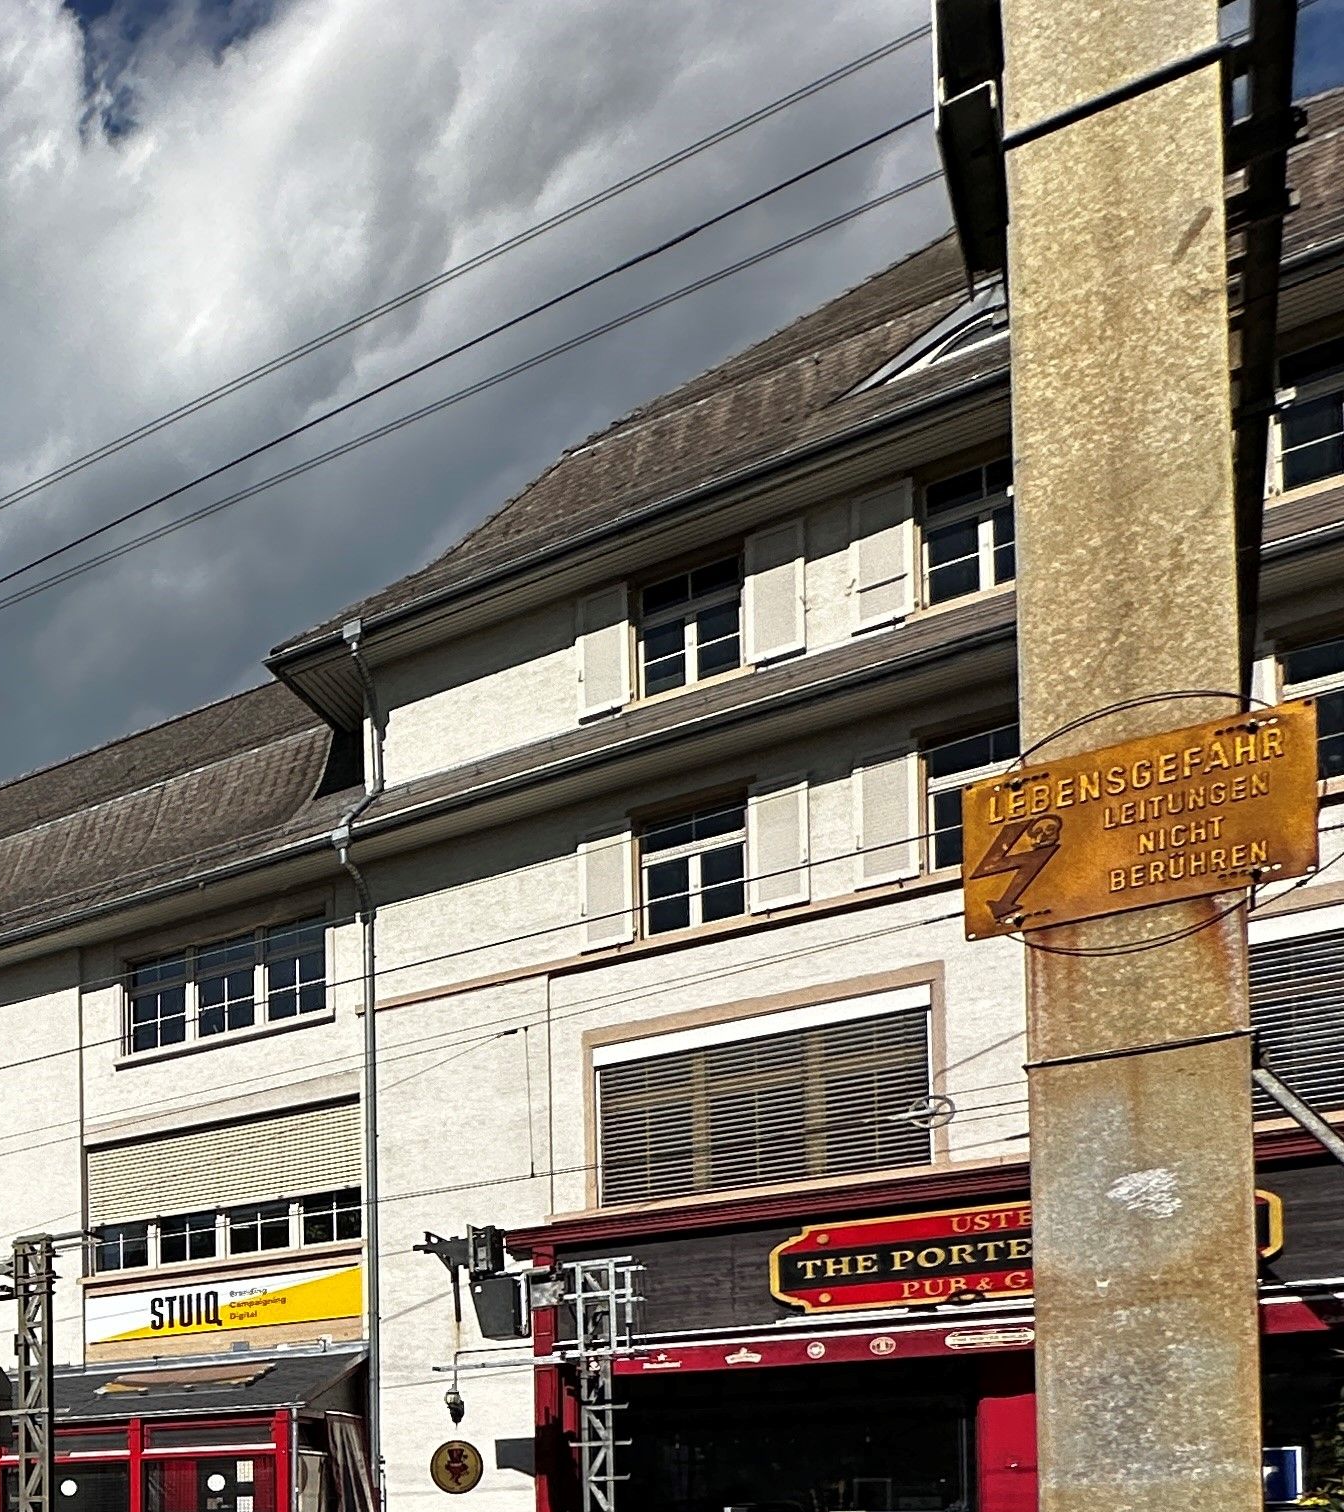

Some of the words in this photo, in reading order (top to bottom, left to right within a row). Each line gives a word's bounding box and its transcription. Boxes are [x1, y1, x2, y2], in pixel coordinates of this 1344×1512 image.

[987, 726, 1285, 825] LEBENSGEFAHR
[1103, 771, 1271, 830] LEITUNGEN
[1137, 816, 1225, 856] NICHT
[1108, 840, 1269, 893] BERÜHREN
[950, 1209, 1032, 1233] USTE
[796, 1254, 878, 1280] THE
[889, 1237, 1032, 1271] PORTE
[229, 1287, 268, 1298] Branding
[229, 1296, 287, 1309] Campaigning
[976, 1276, 994, 1291] &
[150, 1290, 223, 1330] STUIQ
[229, 1310, 258, 1321] Digital
